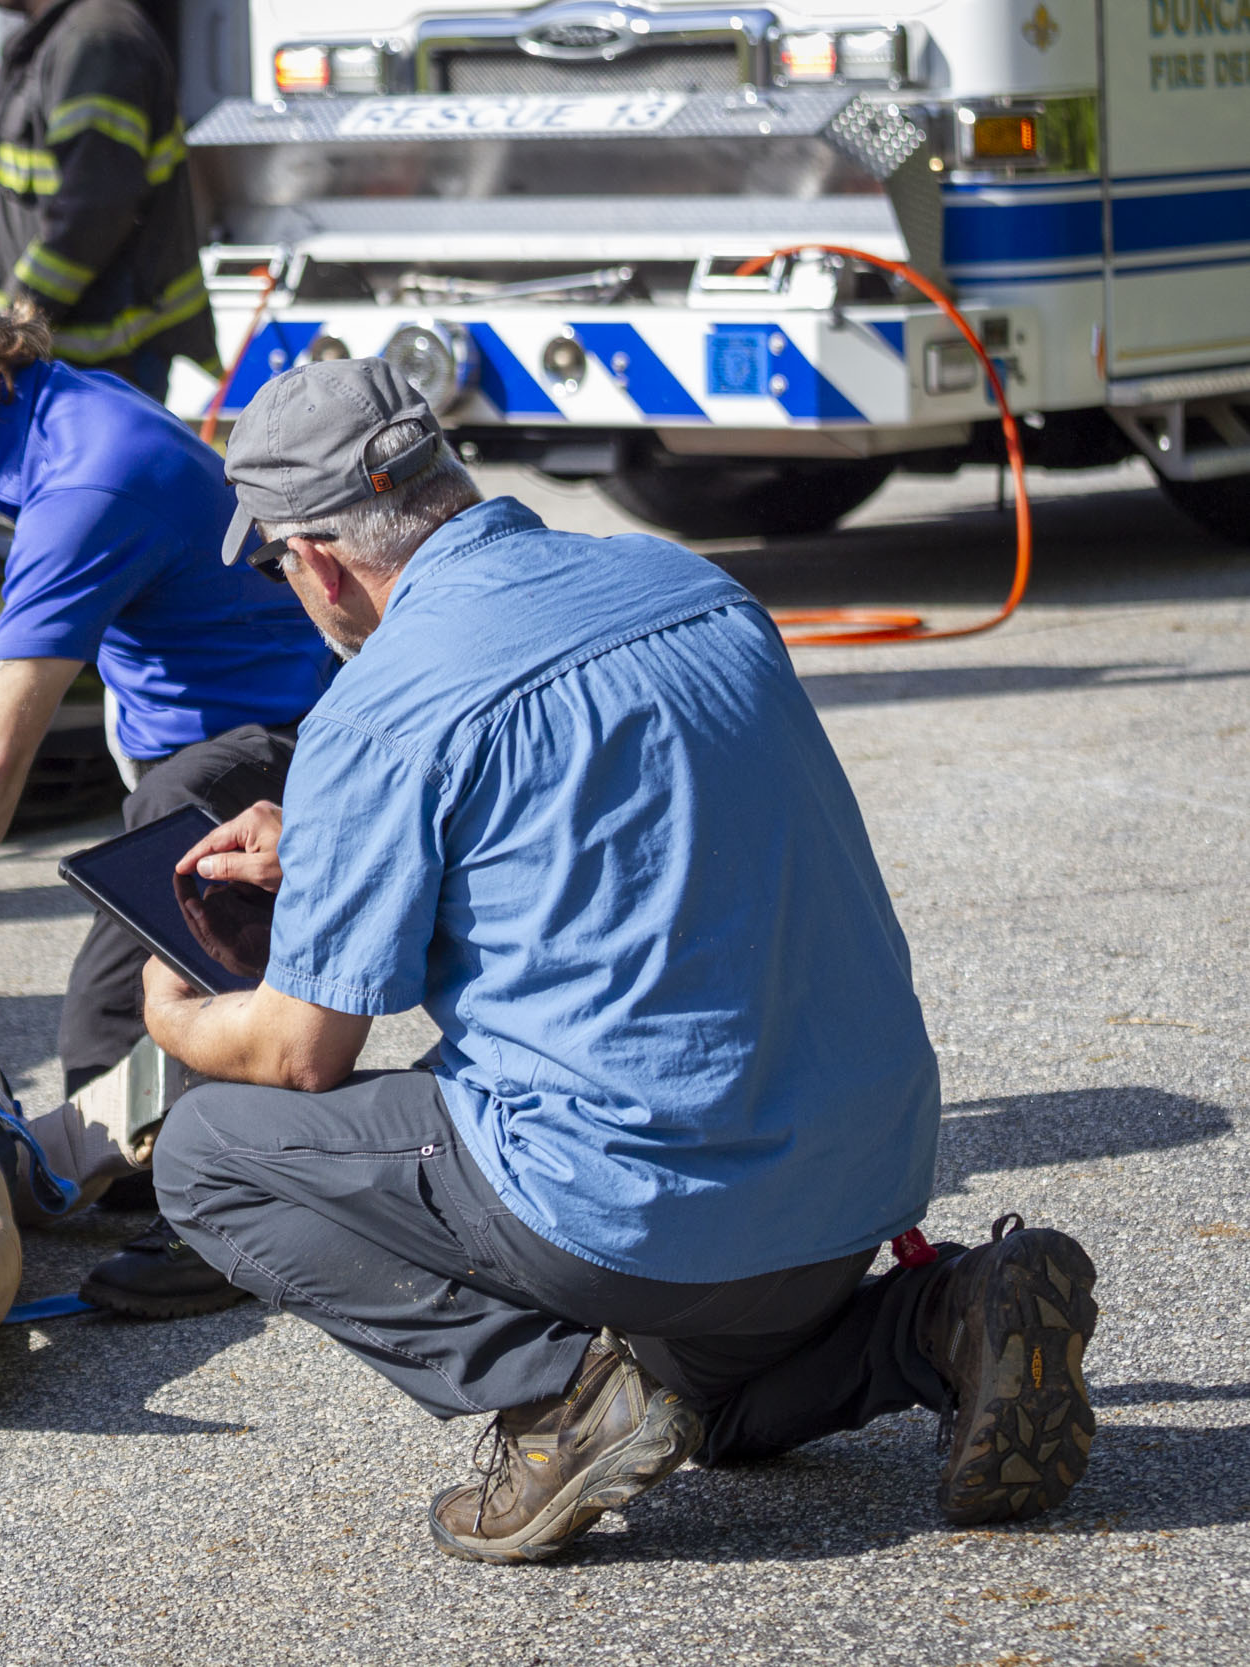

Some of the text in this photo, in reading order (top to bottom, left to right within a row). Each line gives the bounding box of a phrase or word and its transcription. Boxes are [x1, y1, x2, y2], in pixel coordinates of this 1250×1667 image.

[1150, 54, 1207, 91] FIRE
[353, 100, 668, 130] RESCUE 13
